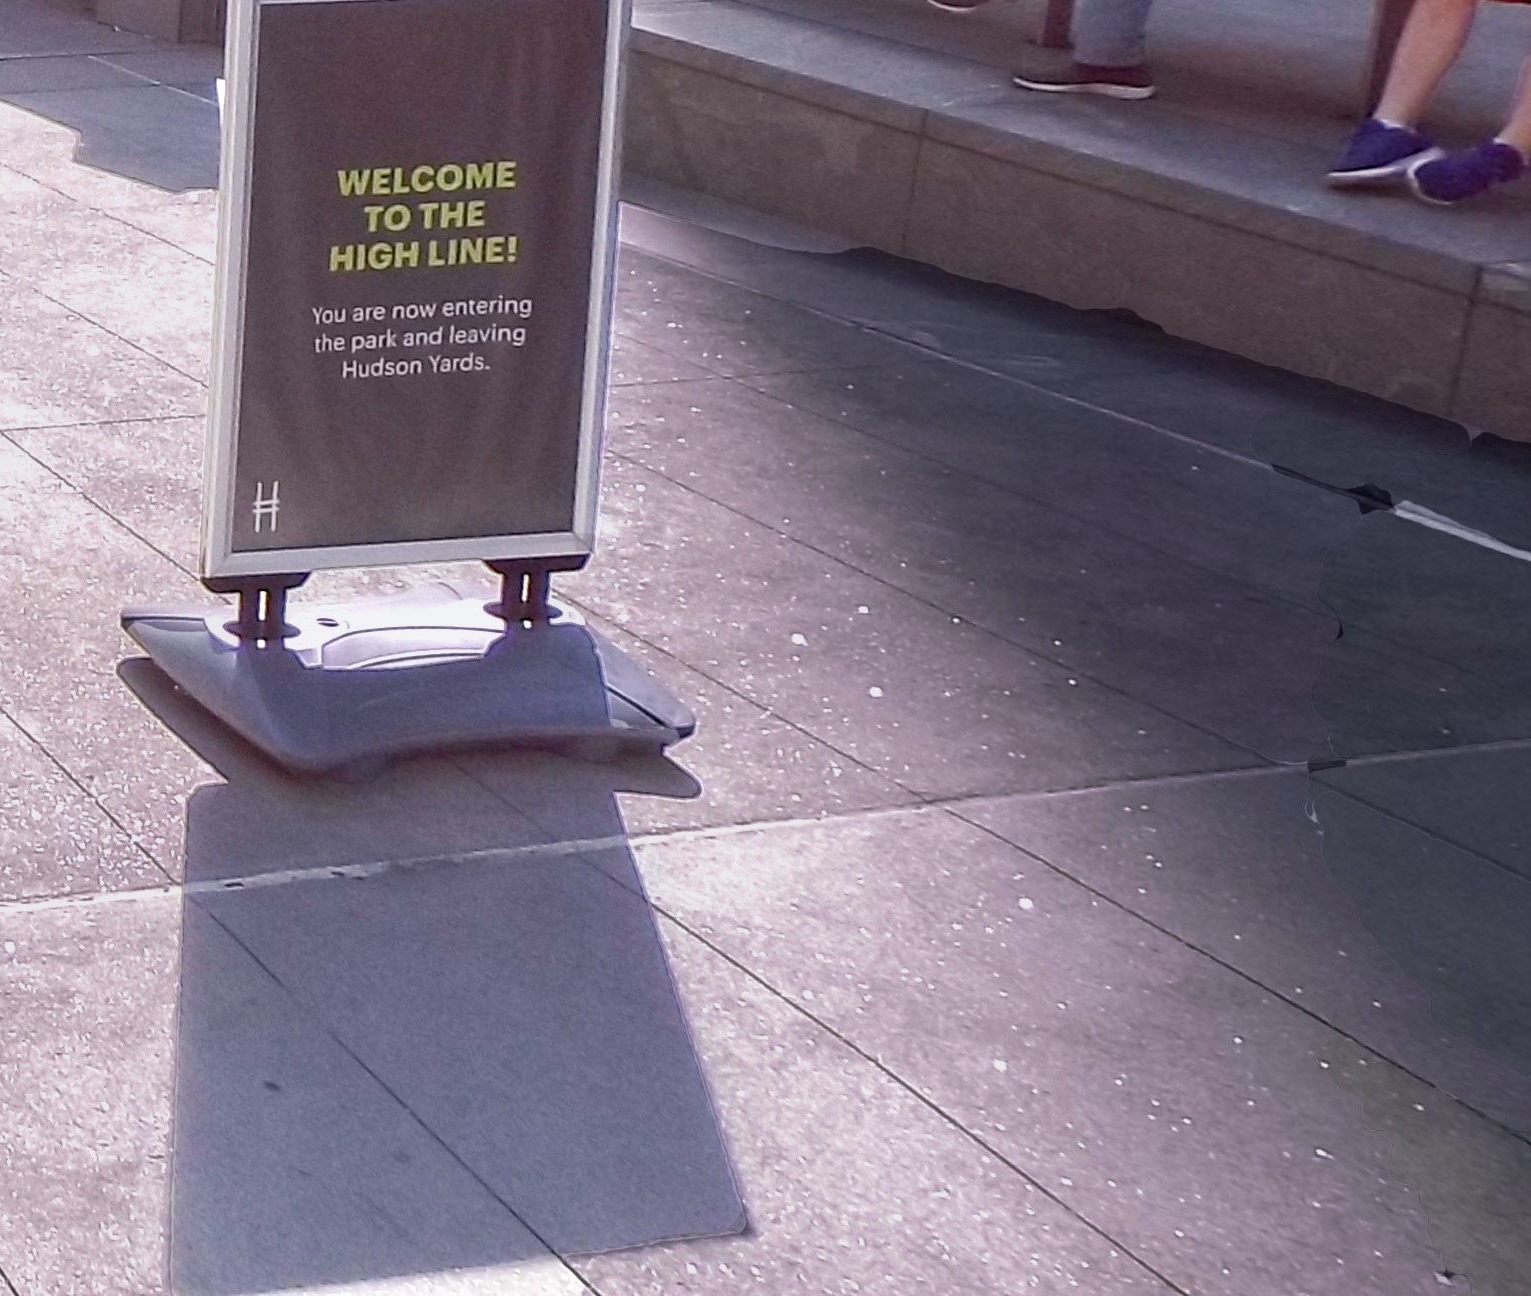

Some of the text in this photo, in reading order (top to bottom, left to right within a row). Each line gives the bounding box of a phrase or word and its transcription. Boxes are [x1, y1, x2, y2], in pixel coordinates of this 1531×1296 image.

[337, 160, 518, 197] WELCOME
[364, 200, 486, 233] TO THE
[329, 235, 519, 272] HIGH LINE!
[312, 295, 534, 325] You are now entering
[314, 323, 527, 355] the park and leaving
[341, 352, 491, 379] Hudson Yards.
